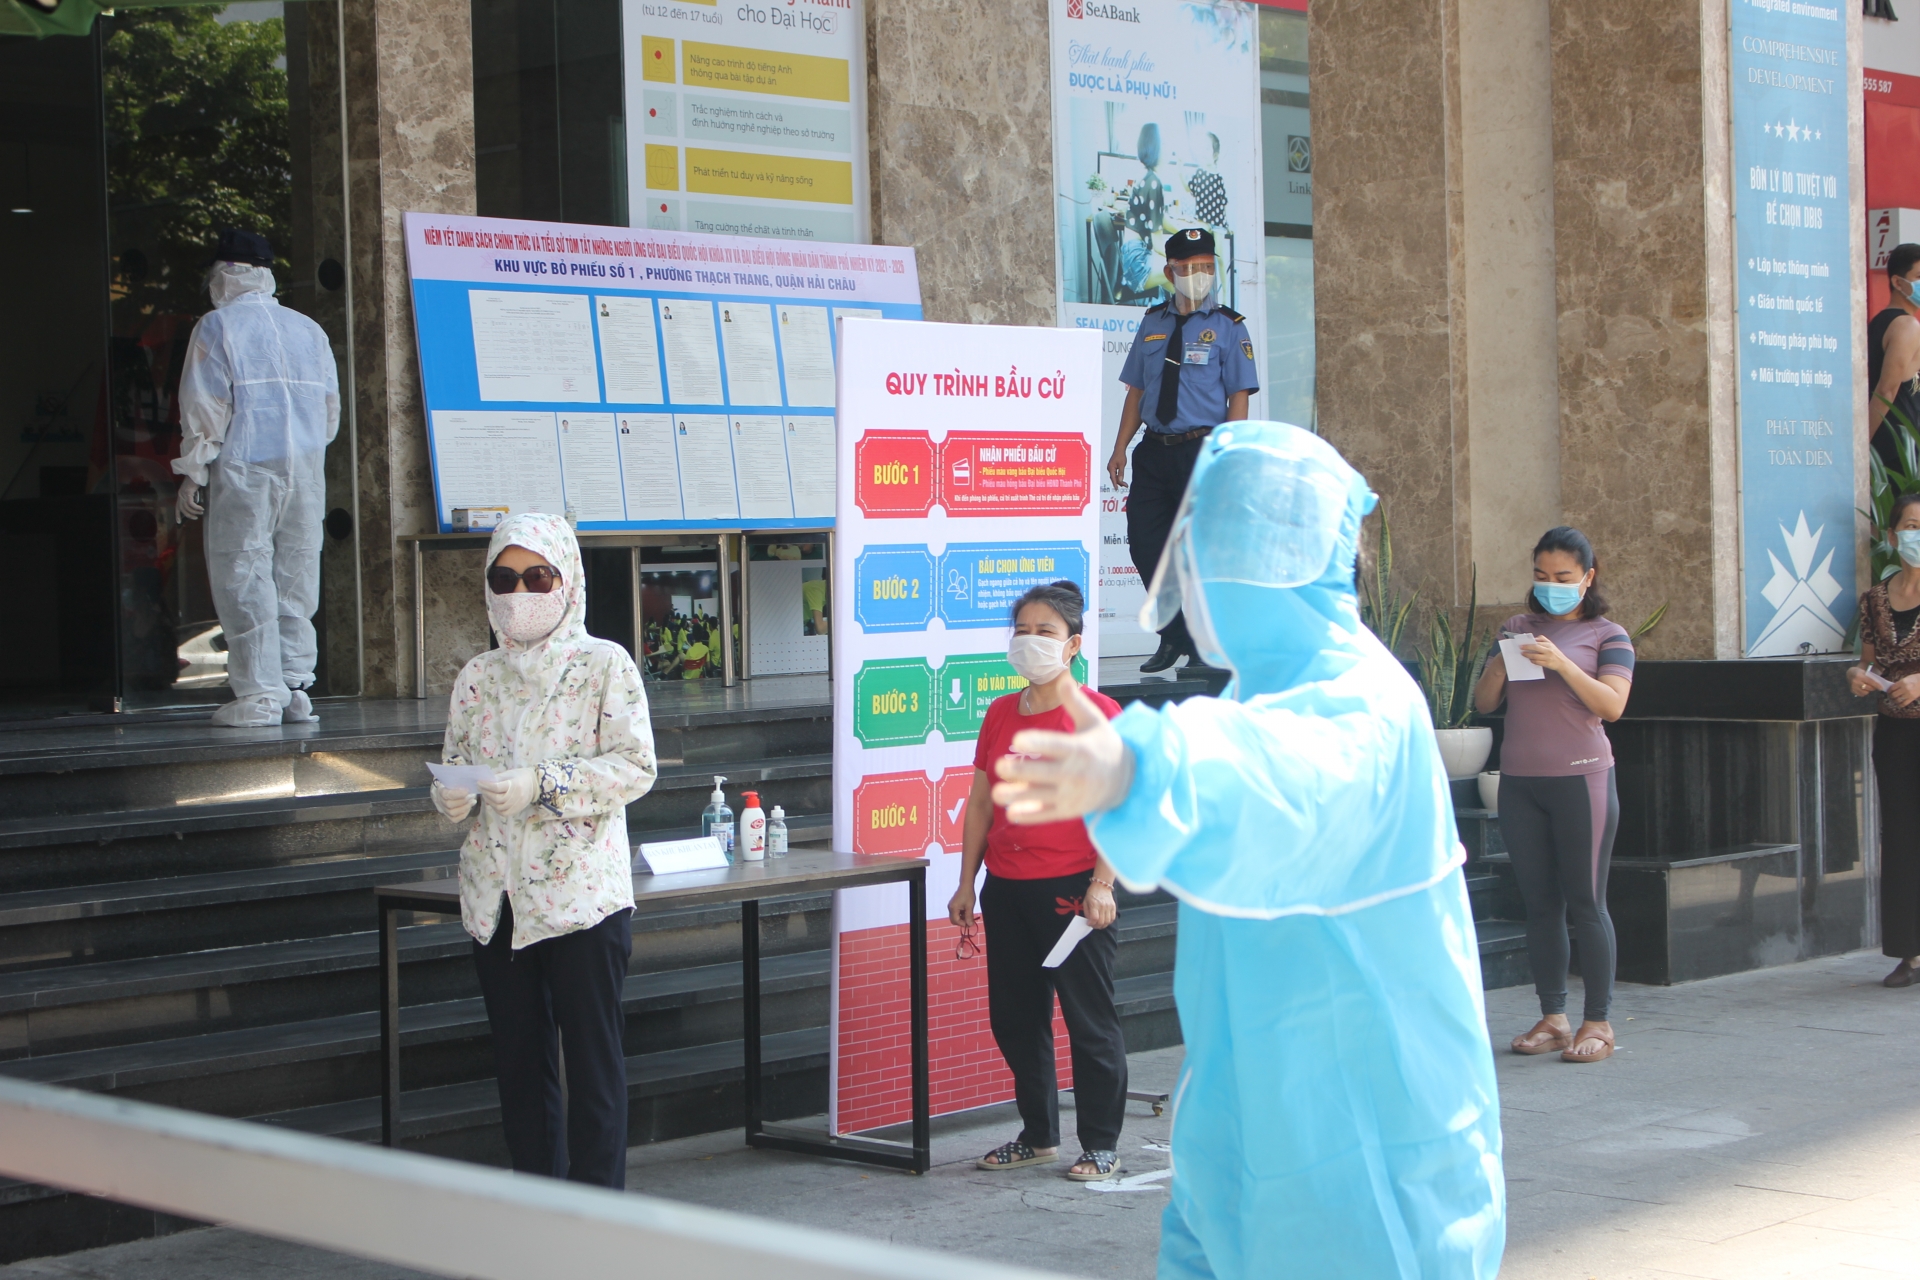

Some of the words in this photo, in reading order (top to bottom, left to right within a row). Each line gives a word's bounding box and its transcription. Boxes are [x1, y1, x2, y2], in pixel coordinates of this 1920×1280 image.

[657, 6, 668, 17] 12
[690, 10, 700, 21] 17
[737, 5, 766, 24] cho
[771, 7, 796, 30] Đại
[800, 11, 831, 34] Học
[1085, 2, 1141, 23] SeABank
[1792, 2, 1838, 21] environment
[1743, 36, 1838, 66] COMPREHENSIVE
[714, 71, 729, 82] qua
[777, 65, 792, 75] Anh
[1069, 72, 1105, 94] ĐƯỢC
[1107, 74, 1123, 94] LÀ
[1125, 79, 1150, 101] PHỤ
[1153, 81, 1171, 99] NỮ
[1173, 86, 1177, 100] !
[1748, 67, 1834, 95] DEVELOPMENT
[1878, 80, 1893, 94] 587
[783, 127, 800, 137] theo
[740, 171, 754, 182] duy
[1782, 172, 1793, 194] DO
[1288, 181, 1312, 195] Link
[1766, 198, 1777, 225] ĐỂ
[1779, 203, 1801, 230] CHỌN
[1804, 206, 1823, 230] DBIS
[782, 227, 796, 236] tinh
[456, 230, 475, 248] DANH
[725, 247, 733, 264] XV
[875, 258, 889, 273] 2021
[891, 259, 905, 274] 2026
[494, 258, 520, 273] KHU
[523, 260, 548, 277] VỰC
[551, 259, 568, 275] BỎ
[571, 261, 606, 278] PHIẾU
[610, 262, 625, 279] SỐ
[628, 267, 635, 279] 1
[646, 265, 693, 282] PHƯỜNG
[695, 270, 732, 286] THẠCH
[733, 272, 773, 288] THANG,
[776, 273, 805, 290] QUẬN
[807, 274, 825, 290] HẢI
[828, 276, 856, 292] CHÂU
[1811, 263, 1829, 277] minh
[885, 372, 928, 396] QUY
[933, 367, 989, 397] TRÌNH
[995, 364, 1032, 399] BẦU
[1037, 369, 1066, 400] CỬ
[1766, 416, 1797, 436] PHÁT
[1801, 415, 1834, 440] TRIỂN
[980, 445, 1002, 465] NHẬN
[1003, 444, 1027, 462] PHIẾU
[1028, 444, 1044, 463] BẦU
[1045, 444, 1057, 463] CỬ
[1768, 446, 1802, 466] TOÀN
[1805, 447, 1833, 469] DIỆN
[873, 460, 909, 485] BƯỚC
[913, 465, 919, 485] 1
[1102, 495, 1119, 513] TỚI
[978, 555, 995, 574] BẦU
[996, 559, 1018, 576] CHỌN
[1019, 556, 1036, 573] ỨNG
[1037, 555, 1055, 572] VIÊN
[873, 575, 908, 600] BƯỚC
[911, 579, 919, 599] 2
[978, 672, 989, 692] BỎ
[990, 674, 1005, 691] VÀO
[1007, 672, 1030, 690] THÙN
[872, 689, 907, 715] BƯỚC
[911, 692, 919, 712] 3
[871, 803, 906, 829] BƯỚC
[909, 805, 918, 825] 4
